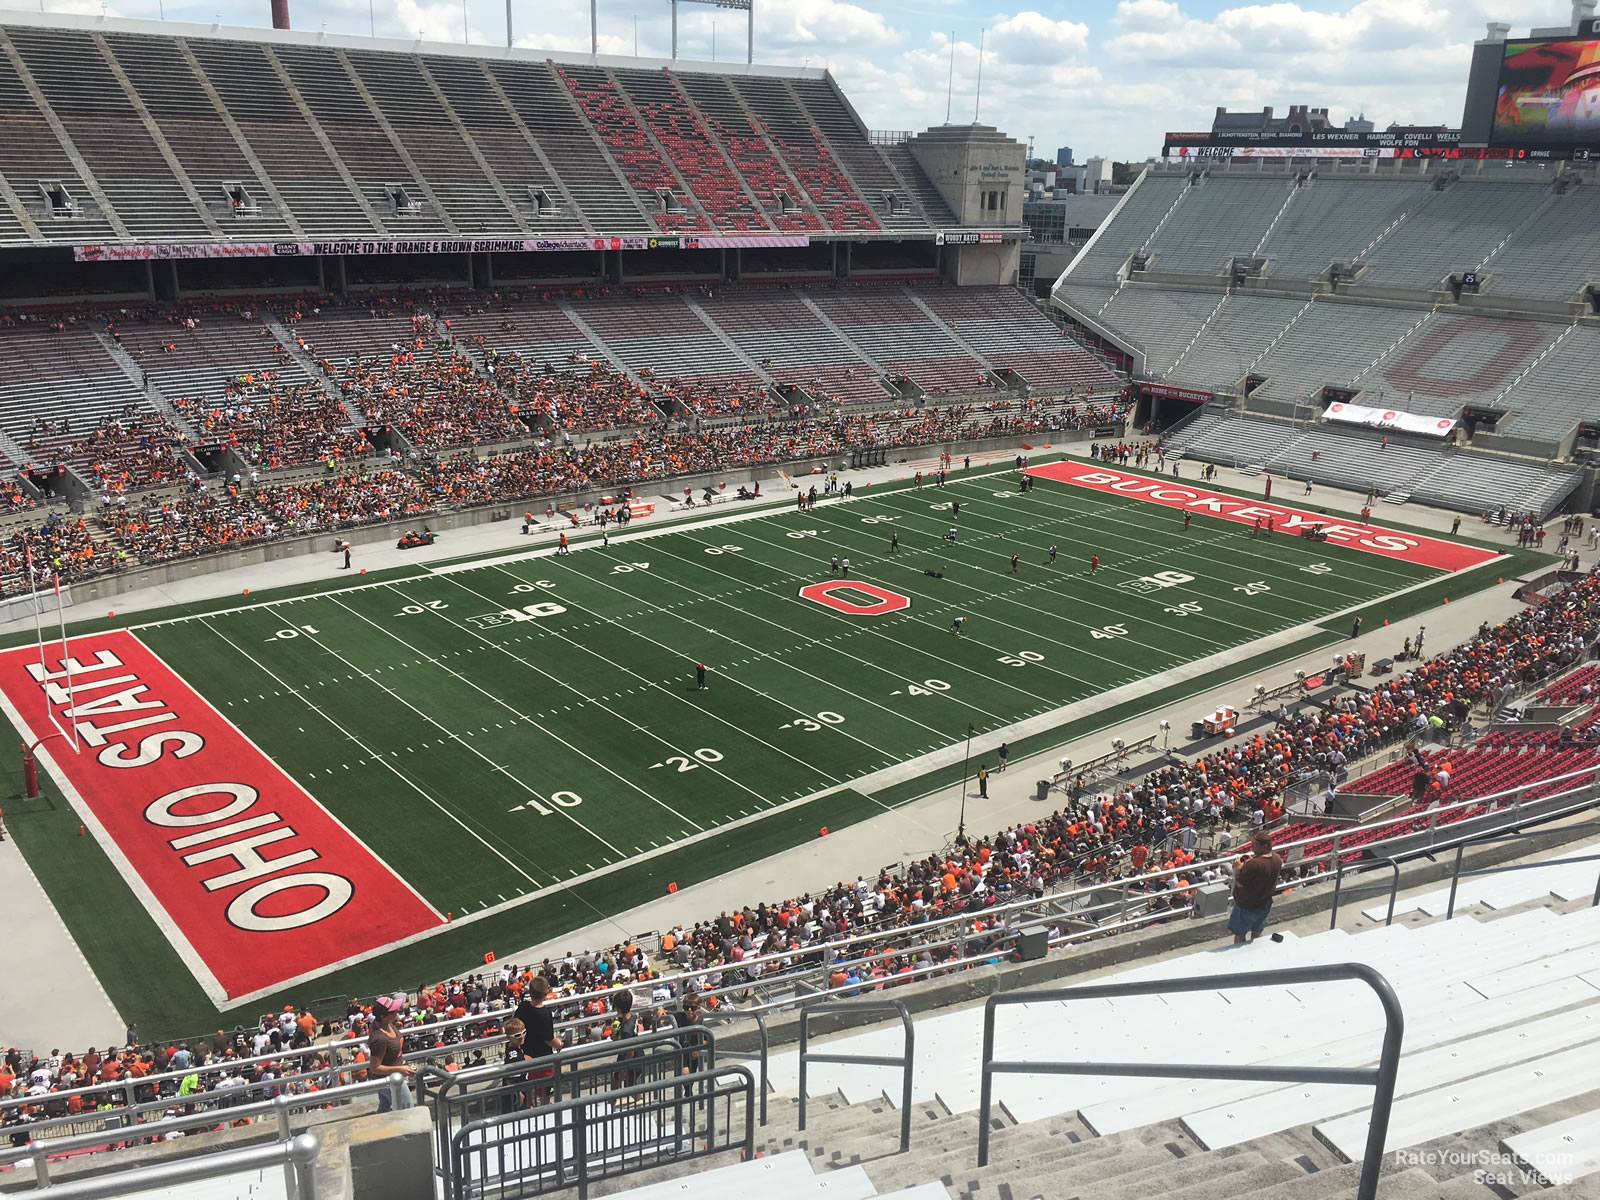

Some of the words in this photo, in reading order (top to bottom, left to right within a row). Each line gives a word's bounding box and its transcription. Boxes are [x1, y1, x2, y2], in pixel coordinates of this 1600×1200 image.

[1198, 147, 1235, 156] WELCOME
[1518, 149, 1525, 158] 0
[313, 243, 359, 254] WELCOME
[362, 243, 374, 254] TO
[376, 242, 393, 253] THE
[396, 242, 430, 253] ORANGE
[433, 242, 439, 252] &
[441, 241, 471, 252] BROWN
[474, 241, 524, 251] SCRIMMAGE
[1179, 392, 1208, 400] BUCKEYES
[1072, 472, 1420, 550] BUCKEYES
[861, 515, 893, 524] 30
[786, 529, 817, 539] 40
[704, 544, 744, 555] 50
[614, 561, 650, 574] 40
[1299, 564, 1332, 574] 10
[513, 579, 556, 594] 30
[1233, 583, 1271, 595] 20
[401, 600, 449, 616] 20
[1163, 603, 1203, 617] 30
[275, 625, 320, 639] 10
[1090, 625, 1129, 640] 40
[997, 651, 1045, 667] 50
[907, 678, 952, 696] 40
[23, 649, 206, 769] STATE
[793, 711, 846, 732] 30
[665, 747, 724, 773] 20
[525, 790, 582, 816] 10
[142, 782, 355, 932] OHIO
[509, 1050, 517, 1059] 32
